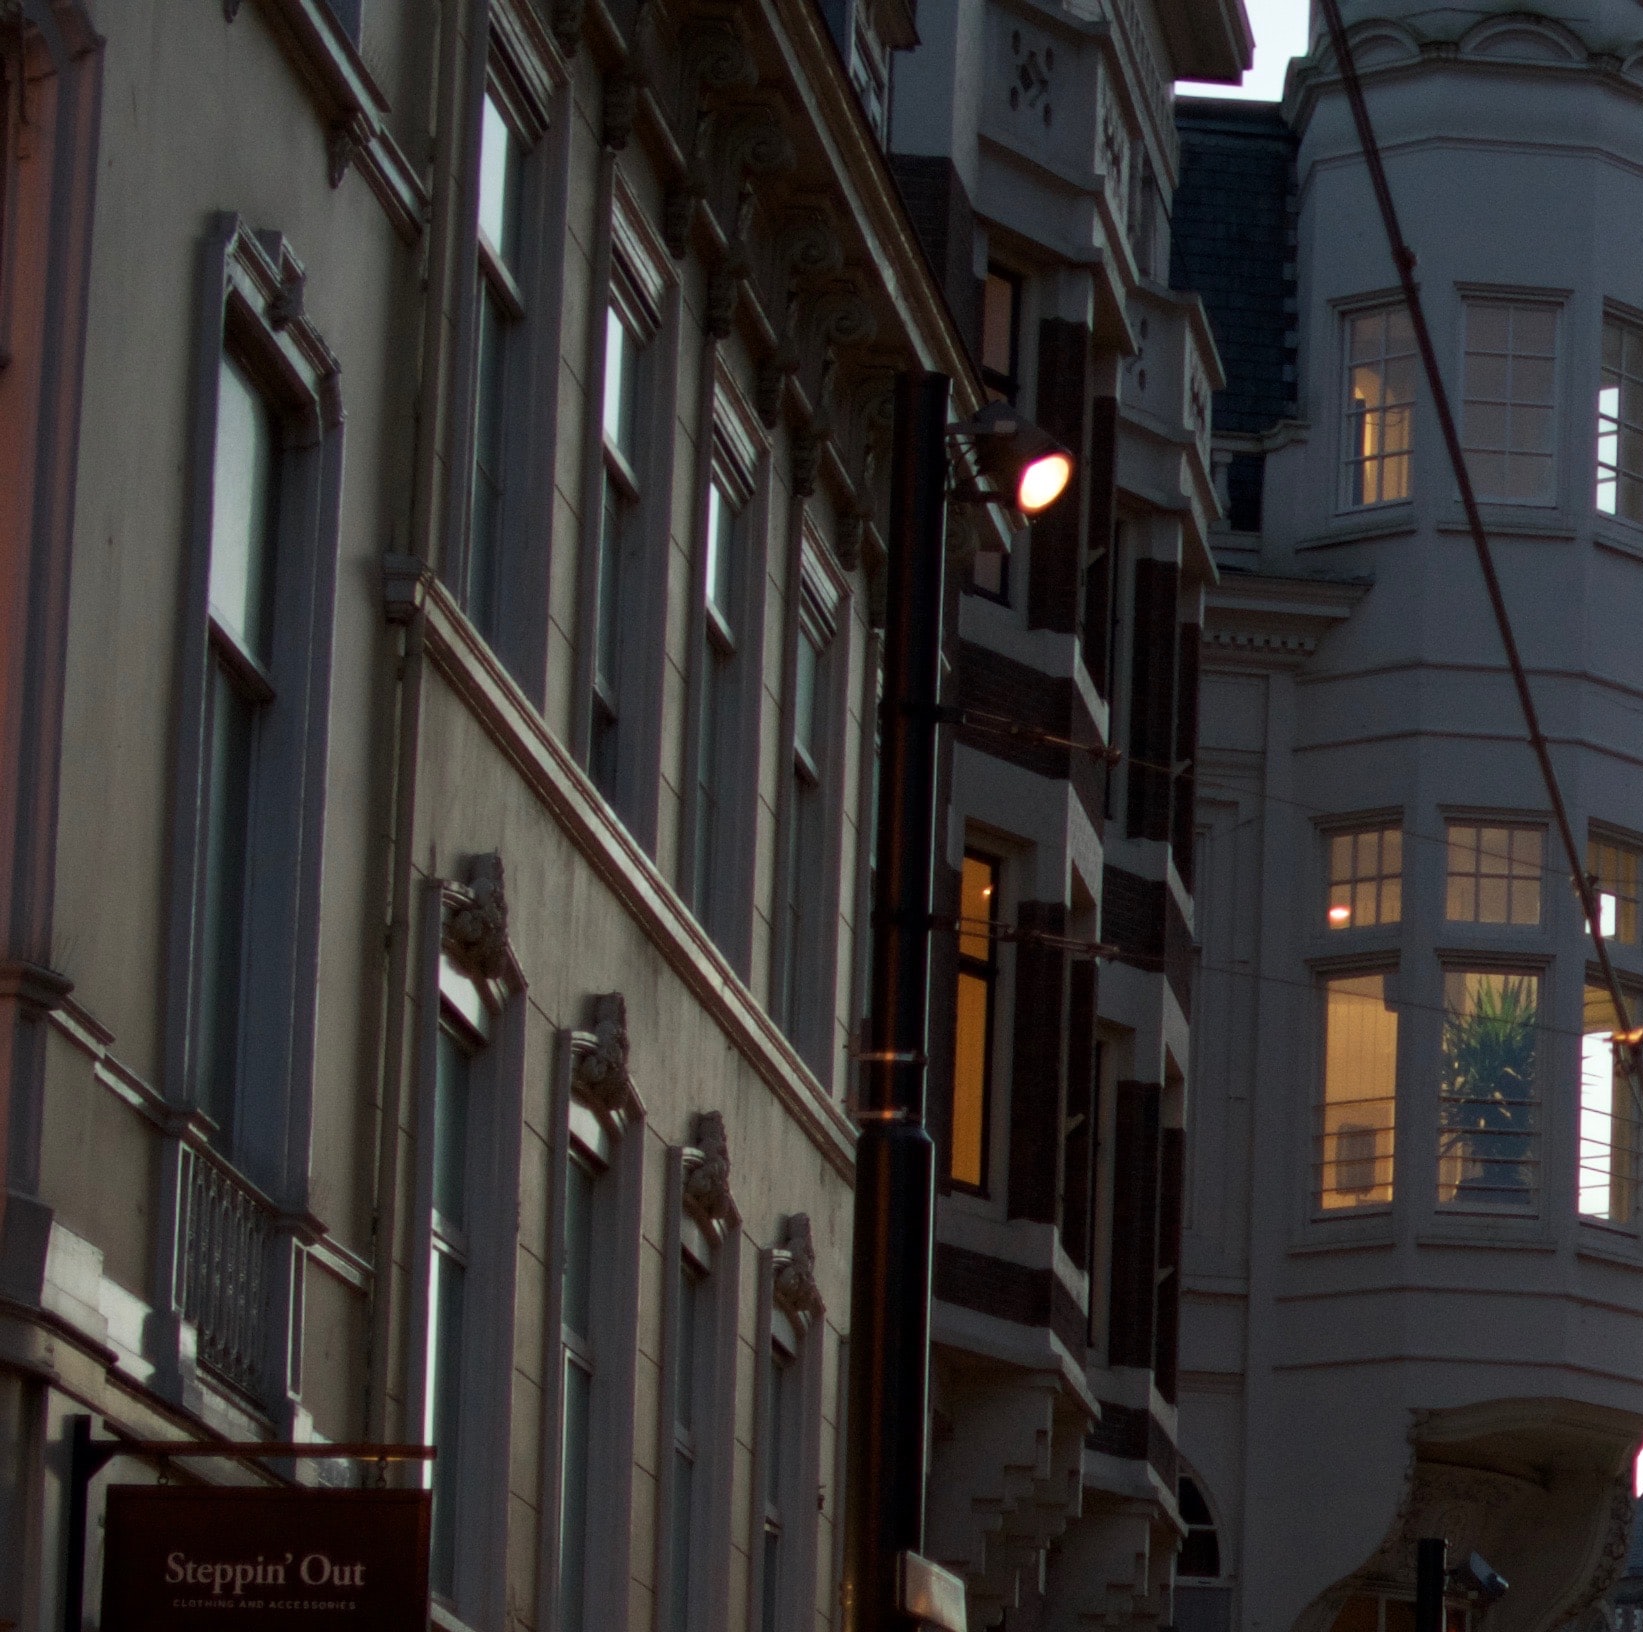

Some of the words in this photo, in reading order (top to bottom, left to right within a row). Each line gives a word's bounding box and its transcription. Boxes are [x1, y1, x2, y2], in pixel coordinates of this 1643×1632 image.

[164, 1550, 294, 1595] Steppin'
[299, 1553, 367, 1587] Out
[172, 1599, 235, 1609] CLOTHING
[238, 1599, 265, 1609] AND
[268, 1600, 357, 1610] ACCESSORIES
